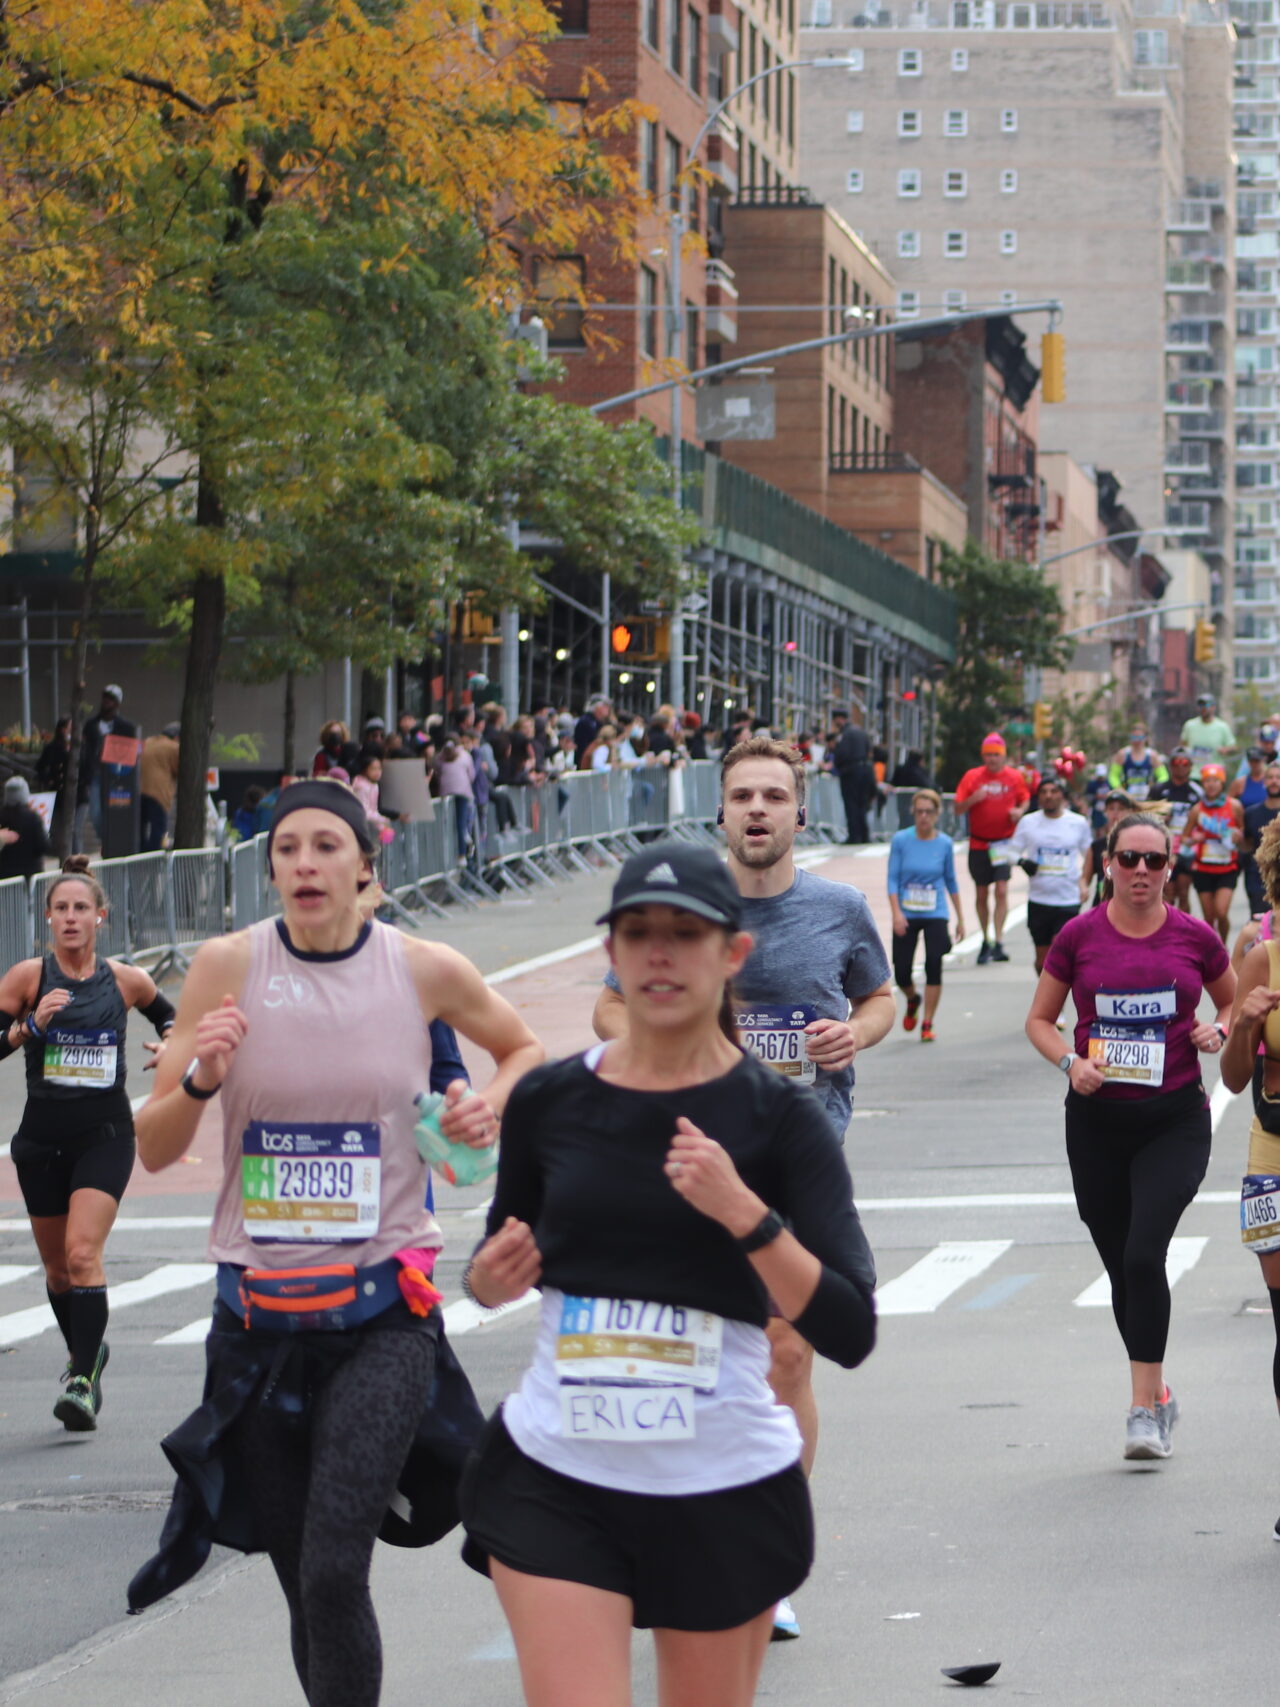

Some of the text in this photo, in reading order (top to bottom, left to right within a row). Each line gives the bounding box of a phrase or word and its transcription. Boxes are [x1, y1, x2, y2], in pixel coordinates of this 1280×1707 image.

[1112, 1000, 1162, 1017] Kara
[745, 1032, 799, 1060] 25676
[1106, 1042, 1150, 1066] 28298
[262, 1129, 294, 1152] tcs
[340, 1143, 365, 1153] TATA
[279, 1160, 354, 1199] 23839
[569, 1394, 688, 1433] ERICA
